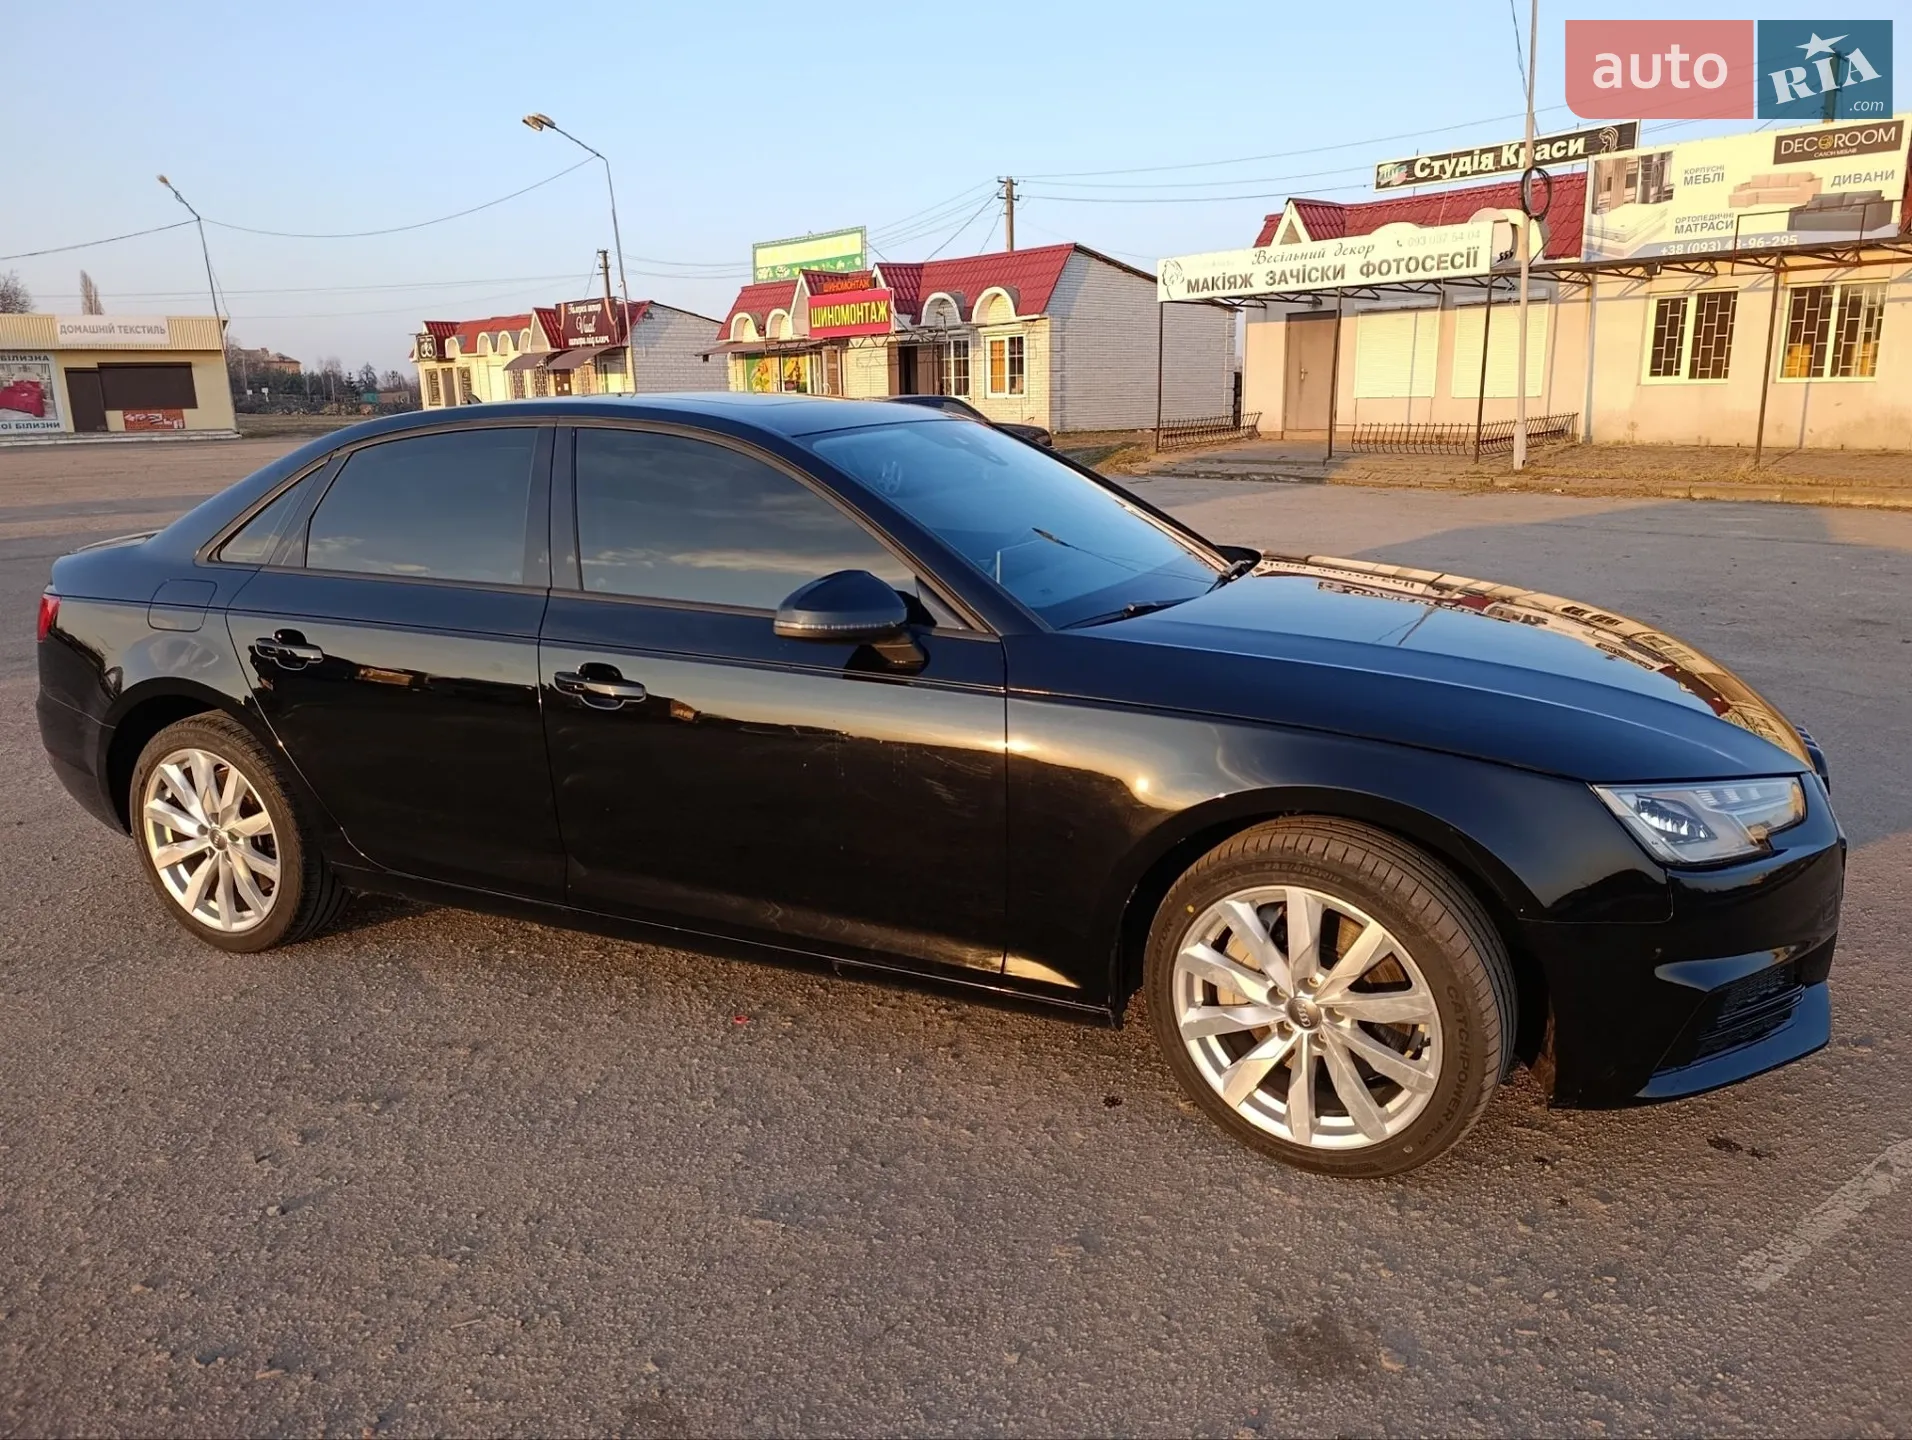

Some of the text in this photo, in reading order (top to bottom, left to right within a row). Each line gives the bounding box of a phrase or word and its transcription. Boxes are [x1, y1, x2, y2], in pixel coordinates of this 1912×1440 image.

[1413, 150, 1495, 180] Студія
[1684, 164, 1725, 175] КОРПУСНІ
[1683, 172, 1725, 186] МЕБЛІ
[1830, 169, 1895, 188] ДИВАНИ
[1675, 212, 1734, 224] ОРТОПЕДИЧНІ
[1674, 220, 1734, 235] МАТРАСИ
[1251, 248, 1326, 266] Весільний
[1334, 242, 1375, 259] декор
[1687, 240, 1721, 254] (093)
[1186, 246, 1480, 294] МАКІЯЖ ЗАЧІСКИ ФОТОСЕСІЇ
[810, 300, 889, 328] ШИНОМОНТАЖ
[59, 322, 166, 335] ДОМАШНІЙ ТЕКСТИЛЬ
[1447, 985, 1470, 1122] CATCHPOWER
